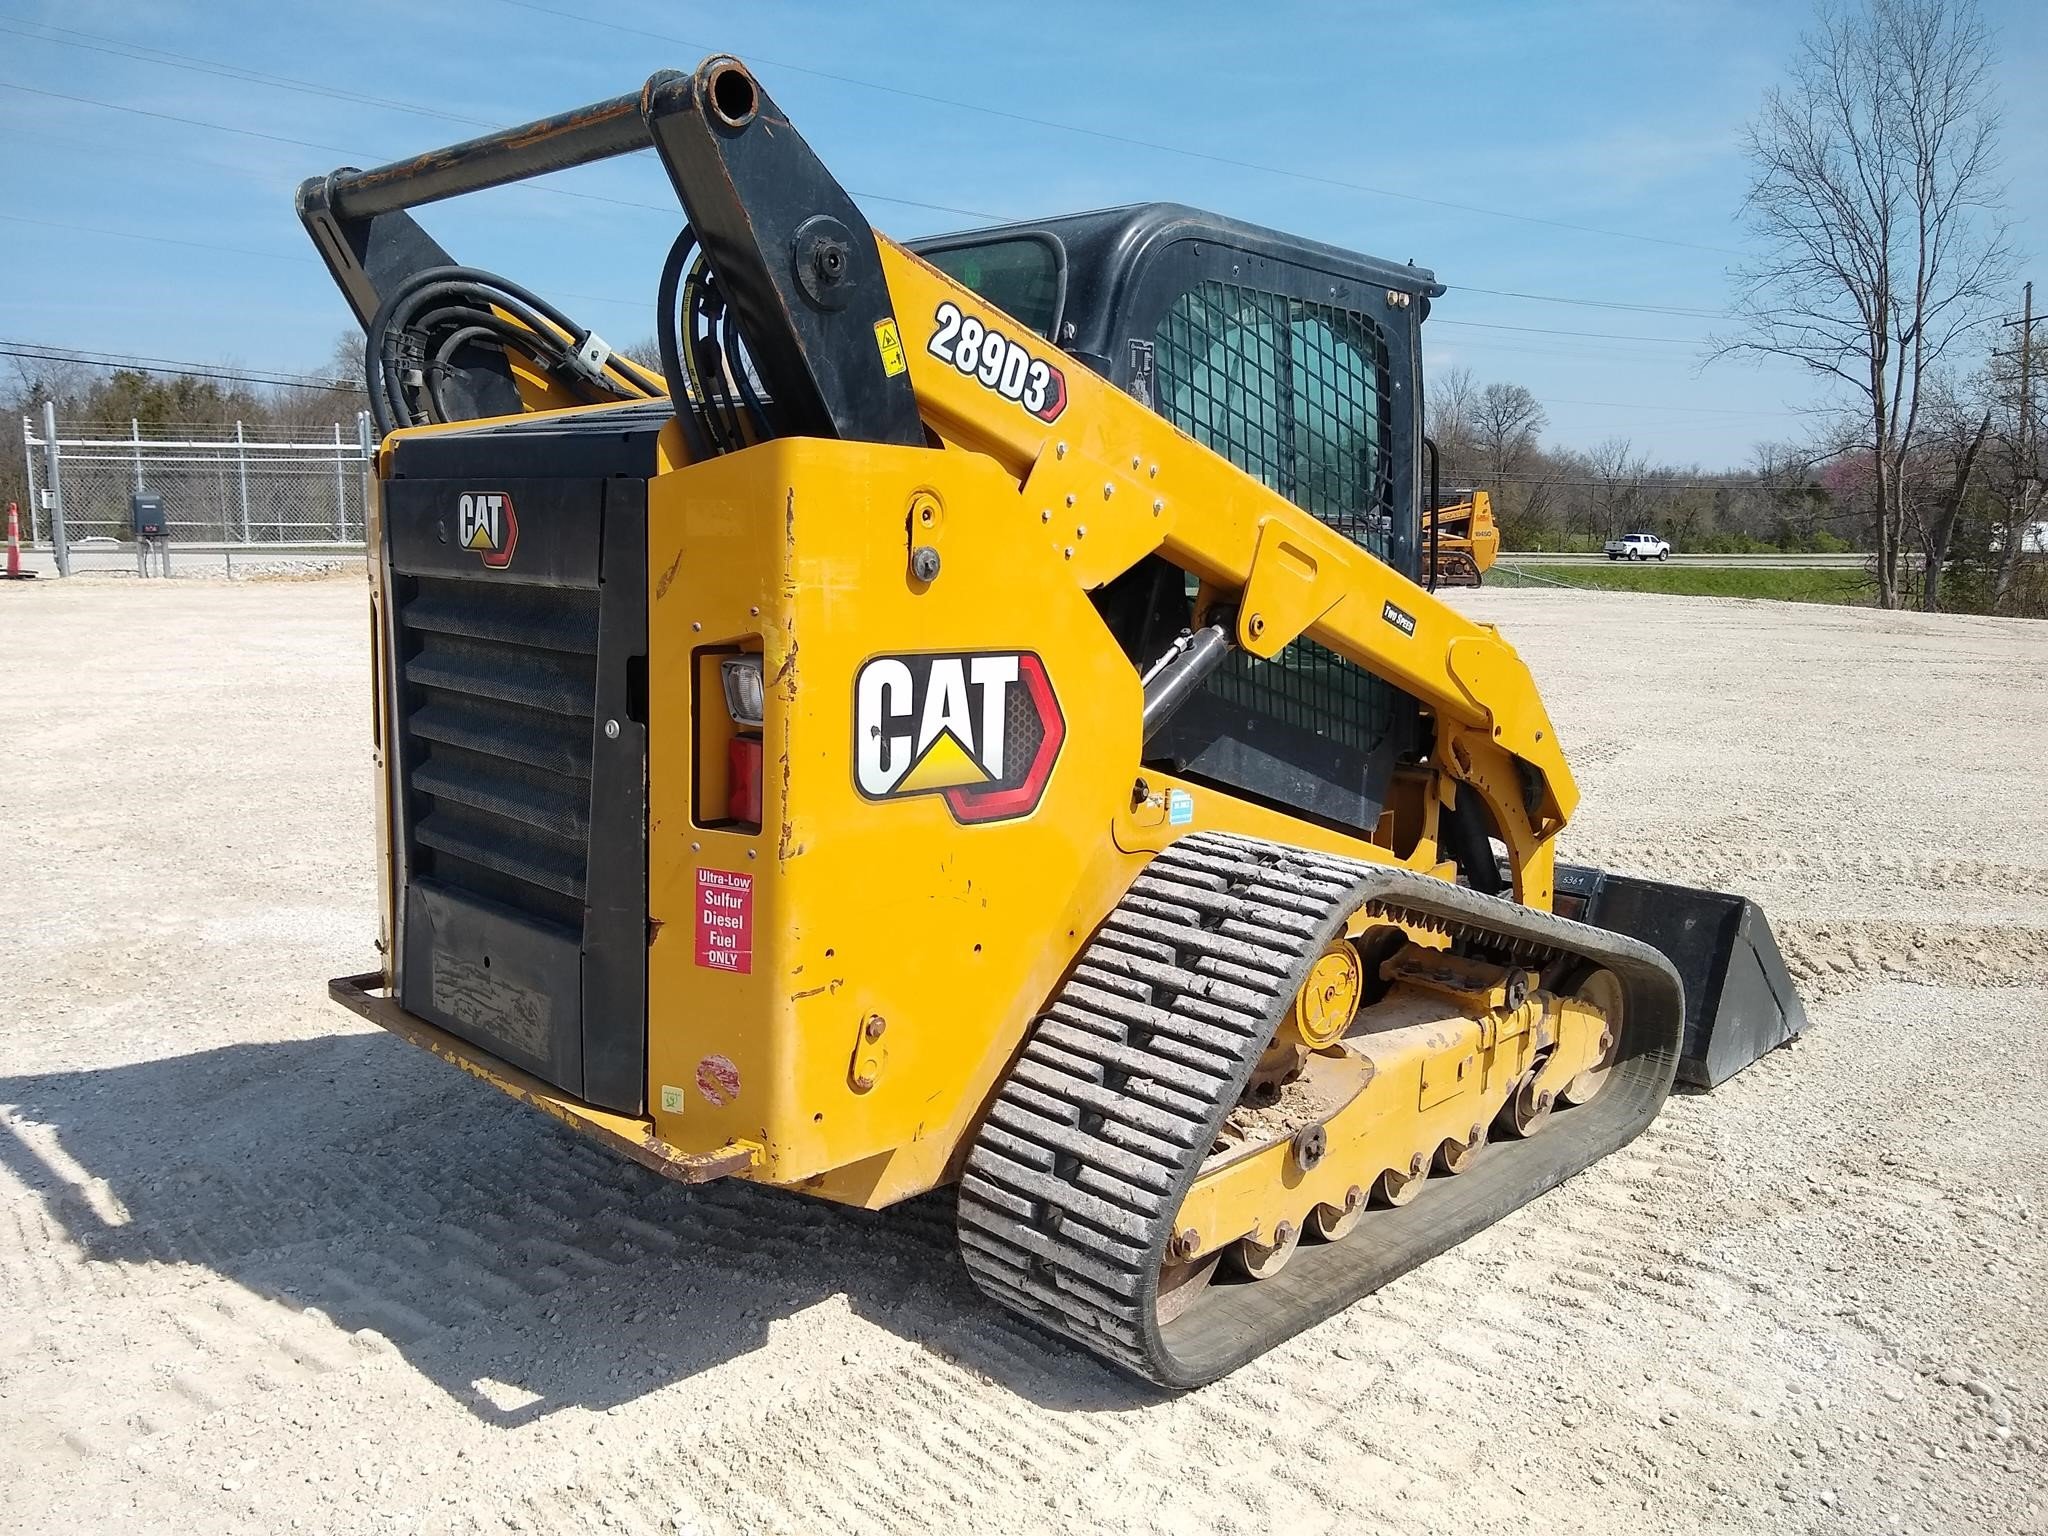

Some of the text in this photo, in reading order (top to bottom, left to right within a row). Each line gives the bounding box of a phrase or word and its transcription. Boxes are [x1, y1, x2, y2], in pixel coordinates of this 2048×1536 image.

[929, 303, 1051, 412] 289D3
[459, 494, 502, 549] CAT
[858, 655, 1019, 795] CAT
[699, 869, 751, 889] Ultra-Low
[705, 890, 743, 909] Sulfur
[703, 909, 743, 929] Diesel
[709, 930, 736, 949] Fuel
[708, 950, 738, 966] ONLY
